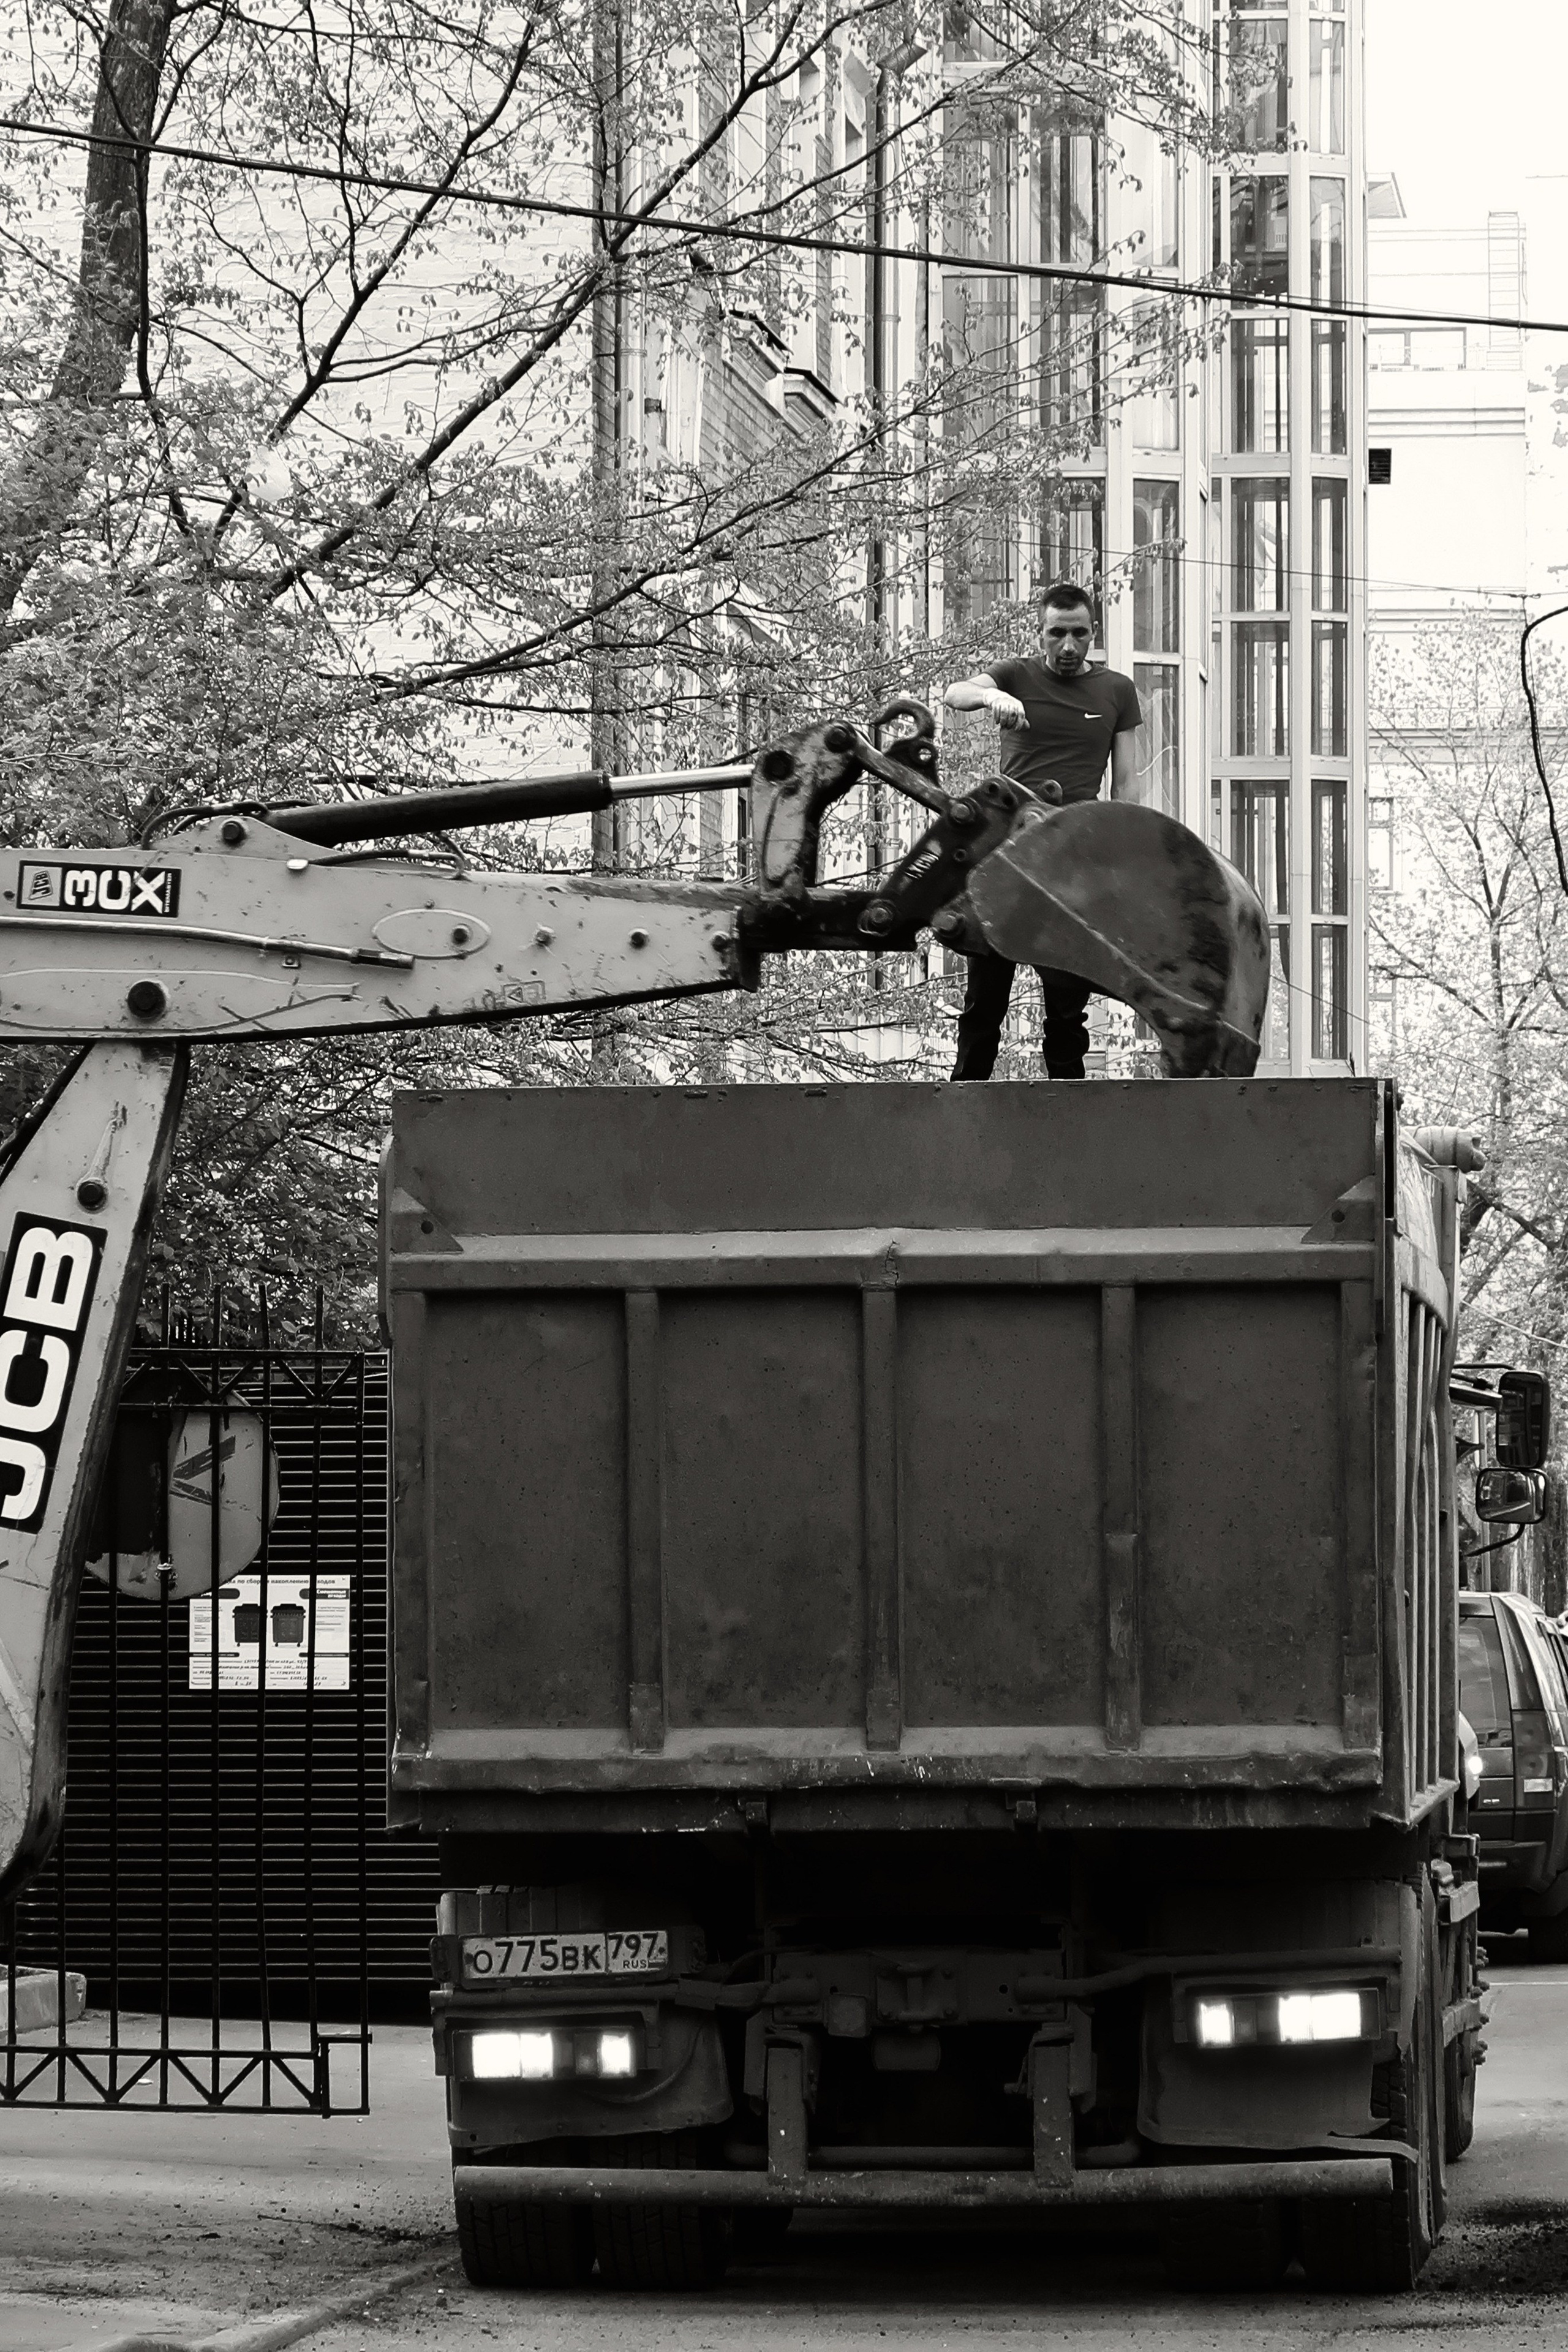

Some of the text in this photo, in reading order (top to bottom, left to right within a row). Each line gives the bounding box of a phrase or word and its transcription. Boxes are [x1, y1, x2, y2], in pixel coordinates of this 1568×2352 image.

[31, 872, 51, 895] JCB
[0, 1227, 93, 1520] JCB
[608, 1932, 660, 1959] 797
[622, 1959, 647, 1969] RUS
